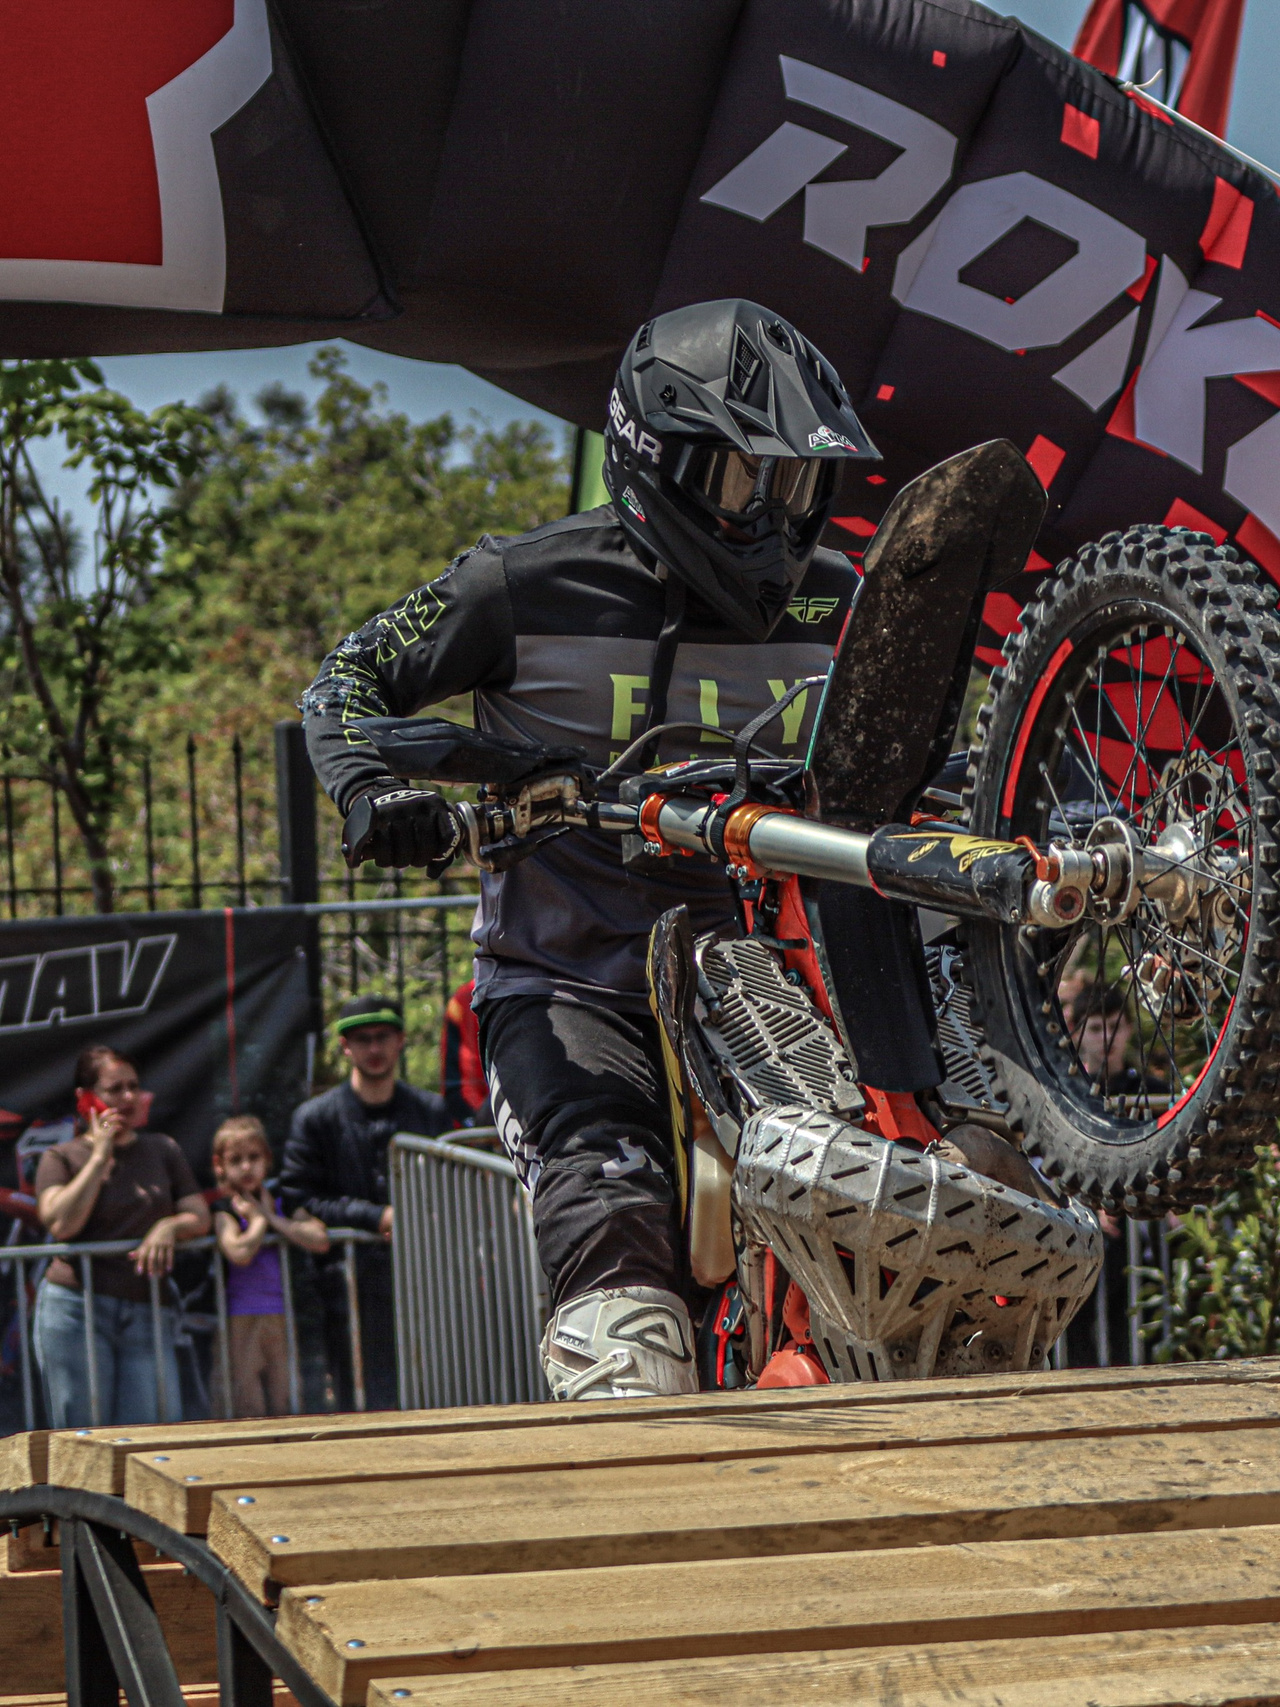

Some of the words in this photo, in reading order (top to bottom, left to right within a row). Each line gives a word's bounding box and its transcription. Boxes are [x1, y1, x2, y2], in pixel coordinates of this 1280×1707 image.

[609, 387, 663, 464] GEAR
[609, 673, 809, 744] FLY
[958, 845, 1017, 873] GEICO
